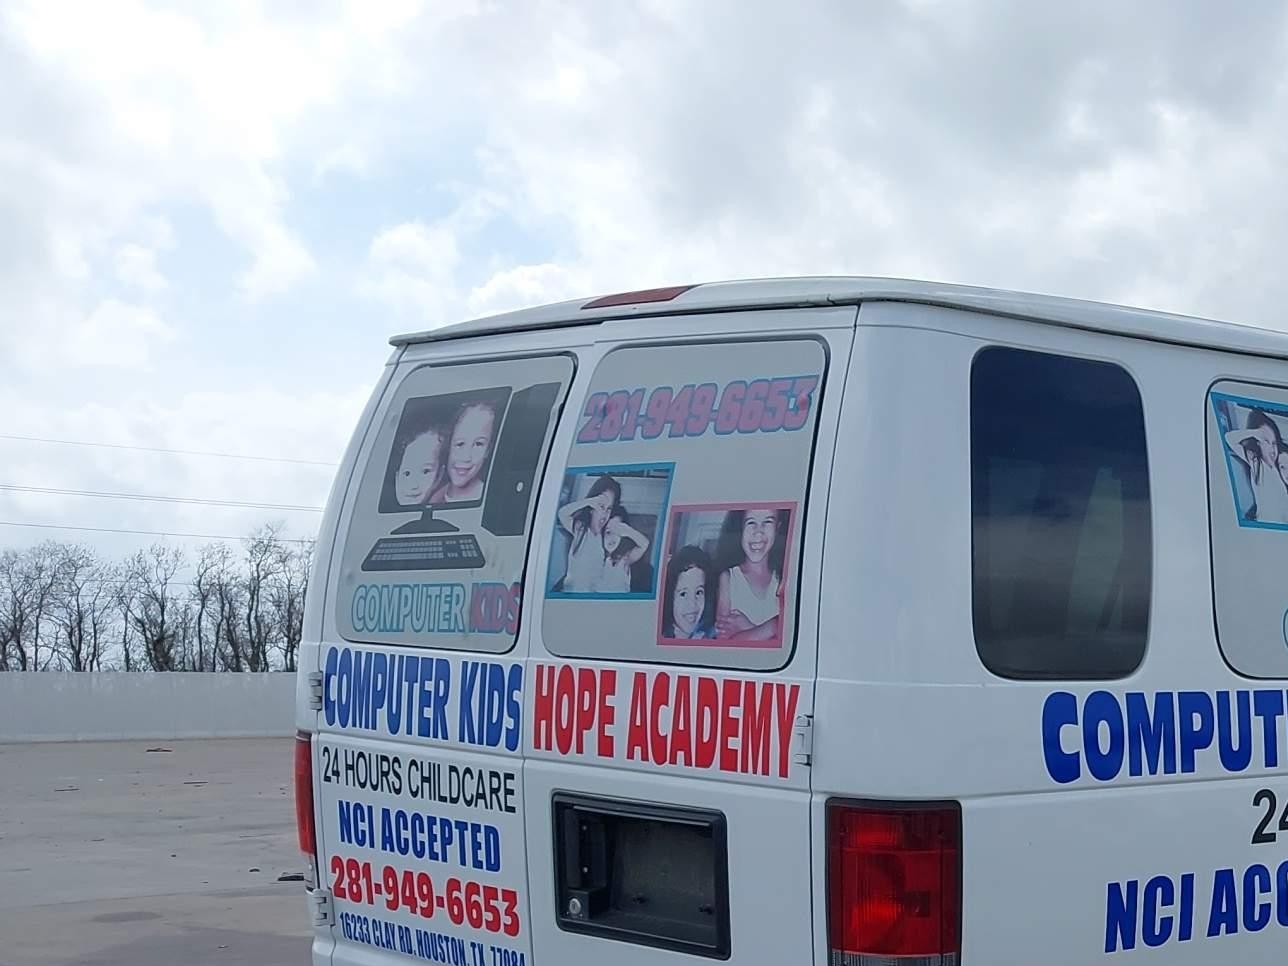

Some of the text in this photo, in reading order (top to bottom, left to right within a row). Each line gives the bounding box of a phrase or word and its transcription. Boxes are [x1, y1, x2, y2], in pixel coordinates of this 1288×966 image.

[574, 374, 819, 444] 281-949-6653
[352, 581, 523, 635] COMPUTER KIDS
[322, 646, 800, 779] COMPUTER KIDS HOPE ACADEMY
[322, 747, 516, 814] 24 HOURS CHILDCARE
[339, 800, 501, 873] NCI ACCEPTED
[330, 855, 520, 938] 281-949-6653
[340, 912, 371, 944] 16233
[372, 918, 397, 951] CLAY
[1104, 872, 1194, 953] NCI
